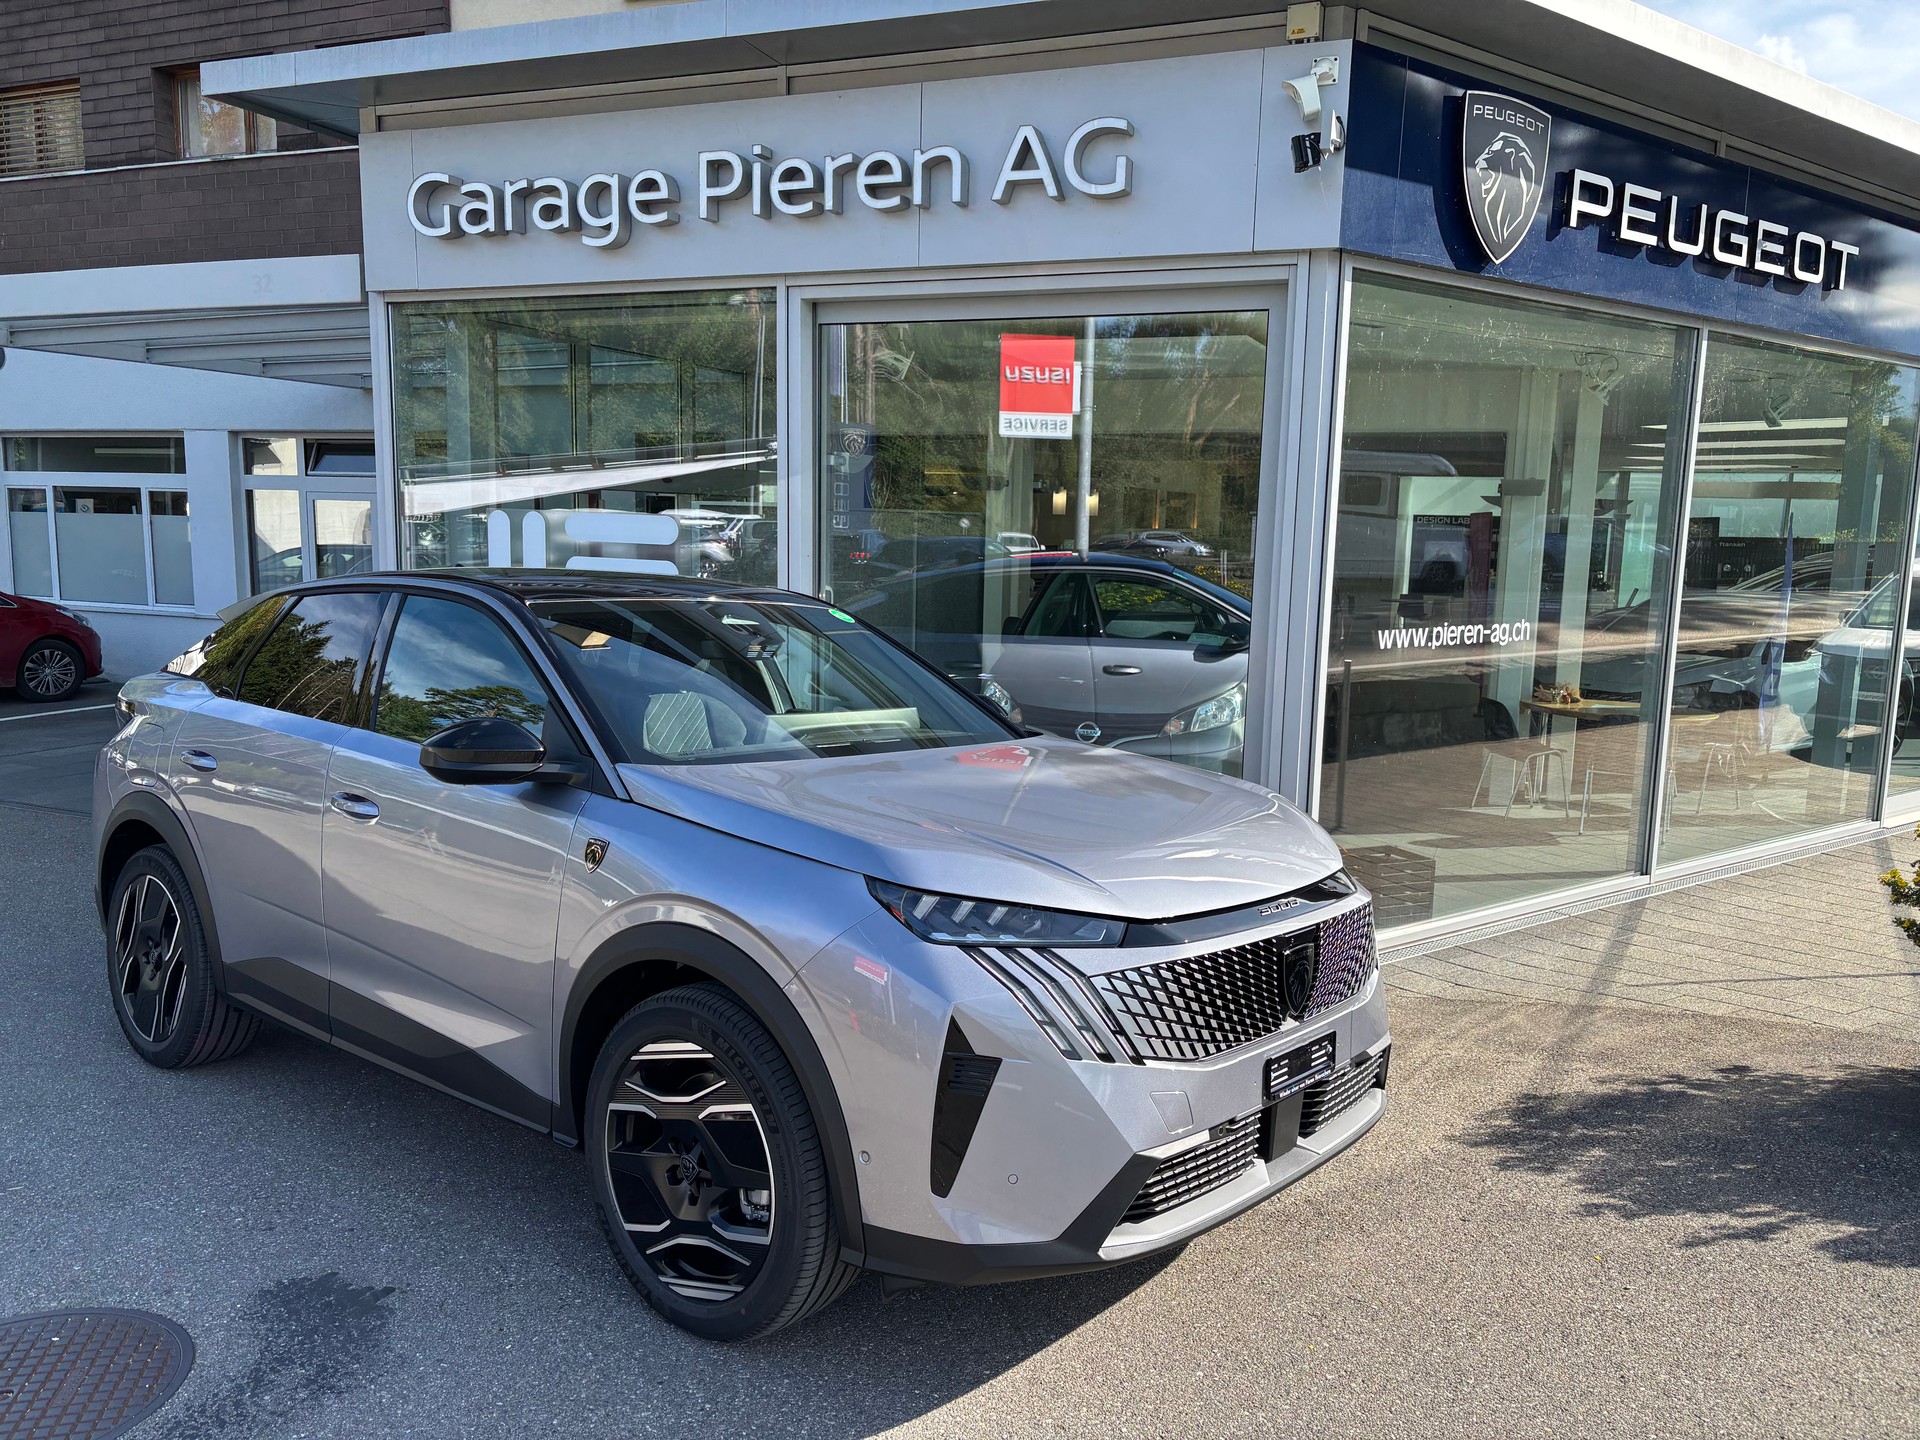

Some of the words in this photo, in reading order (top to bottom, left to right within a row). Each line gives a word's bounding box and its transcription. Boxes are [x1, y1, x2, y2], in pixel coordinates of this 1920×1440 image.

[1473, 104, 1545, 135] PEUGEOT
[406, 169, 677, 248] Garage
[698, 144, 967, 222] Pieren
[991, 116, 1133, 206] AG
[1569, 168, 1860, 291] PEUGEOT
[1416, 516, 1451, 525] DESIGN
[1452, 516, 1471, 525] LAB
[1378, 619, 1530, 650] www.pieren-ag.ch
